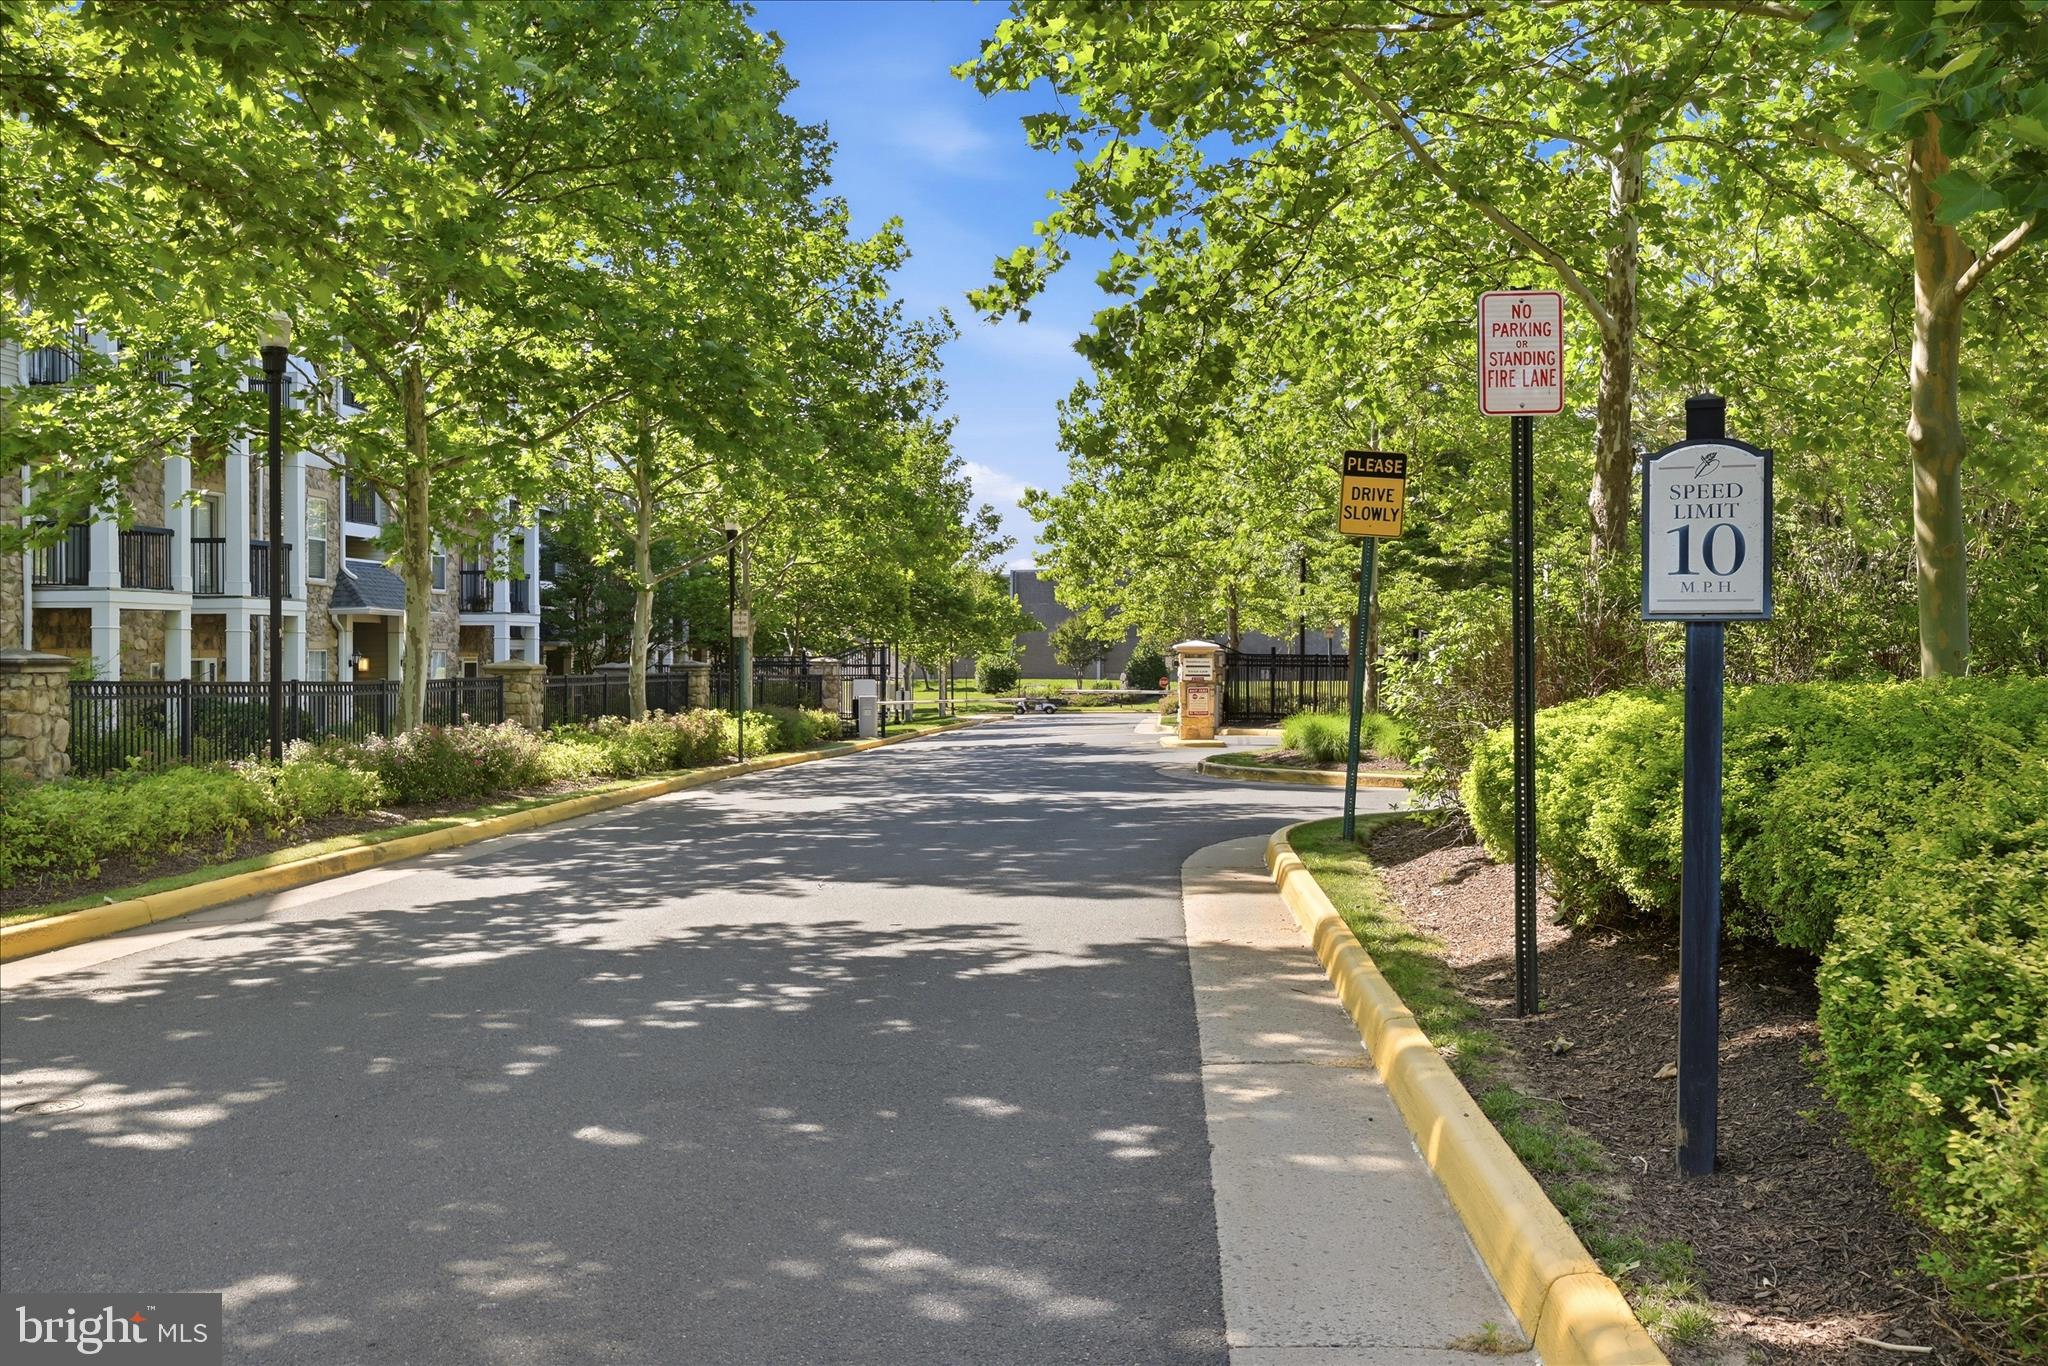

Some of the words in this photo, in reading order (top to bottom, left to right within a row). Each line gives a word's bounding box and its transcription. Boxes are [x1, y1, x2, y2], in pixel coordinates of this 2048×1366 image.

[1511, 304, 1532, 320] NO
[1492, 321, 1552, 338] PARKING
[1515, 340, 1528, 348] OR
[1489, 350, 1556, 367] STANDING
[1488, 369, 1516, 388] FIRE
[1522, 368, 1557, 387] LANE
[1347, 457, 1403, 474] PLEASE
[1351, 486, 1395, 503] DRIVE
[1669, 482, 1744, 500] SPEED
[1343, 505, 1400, 522] SLOWLY
[1673, 502, 1740, 520] LIMIT
[1666, 522, 1746, 577] 10
